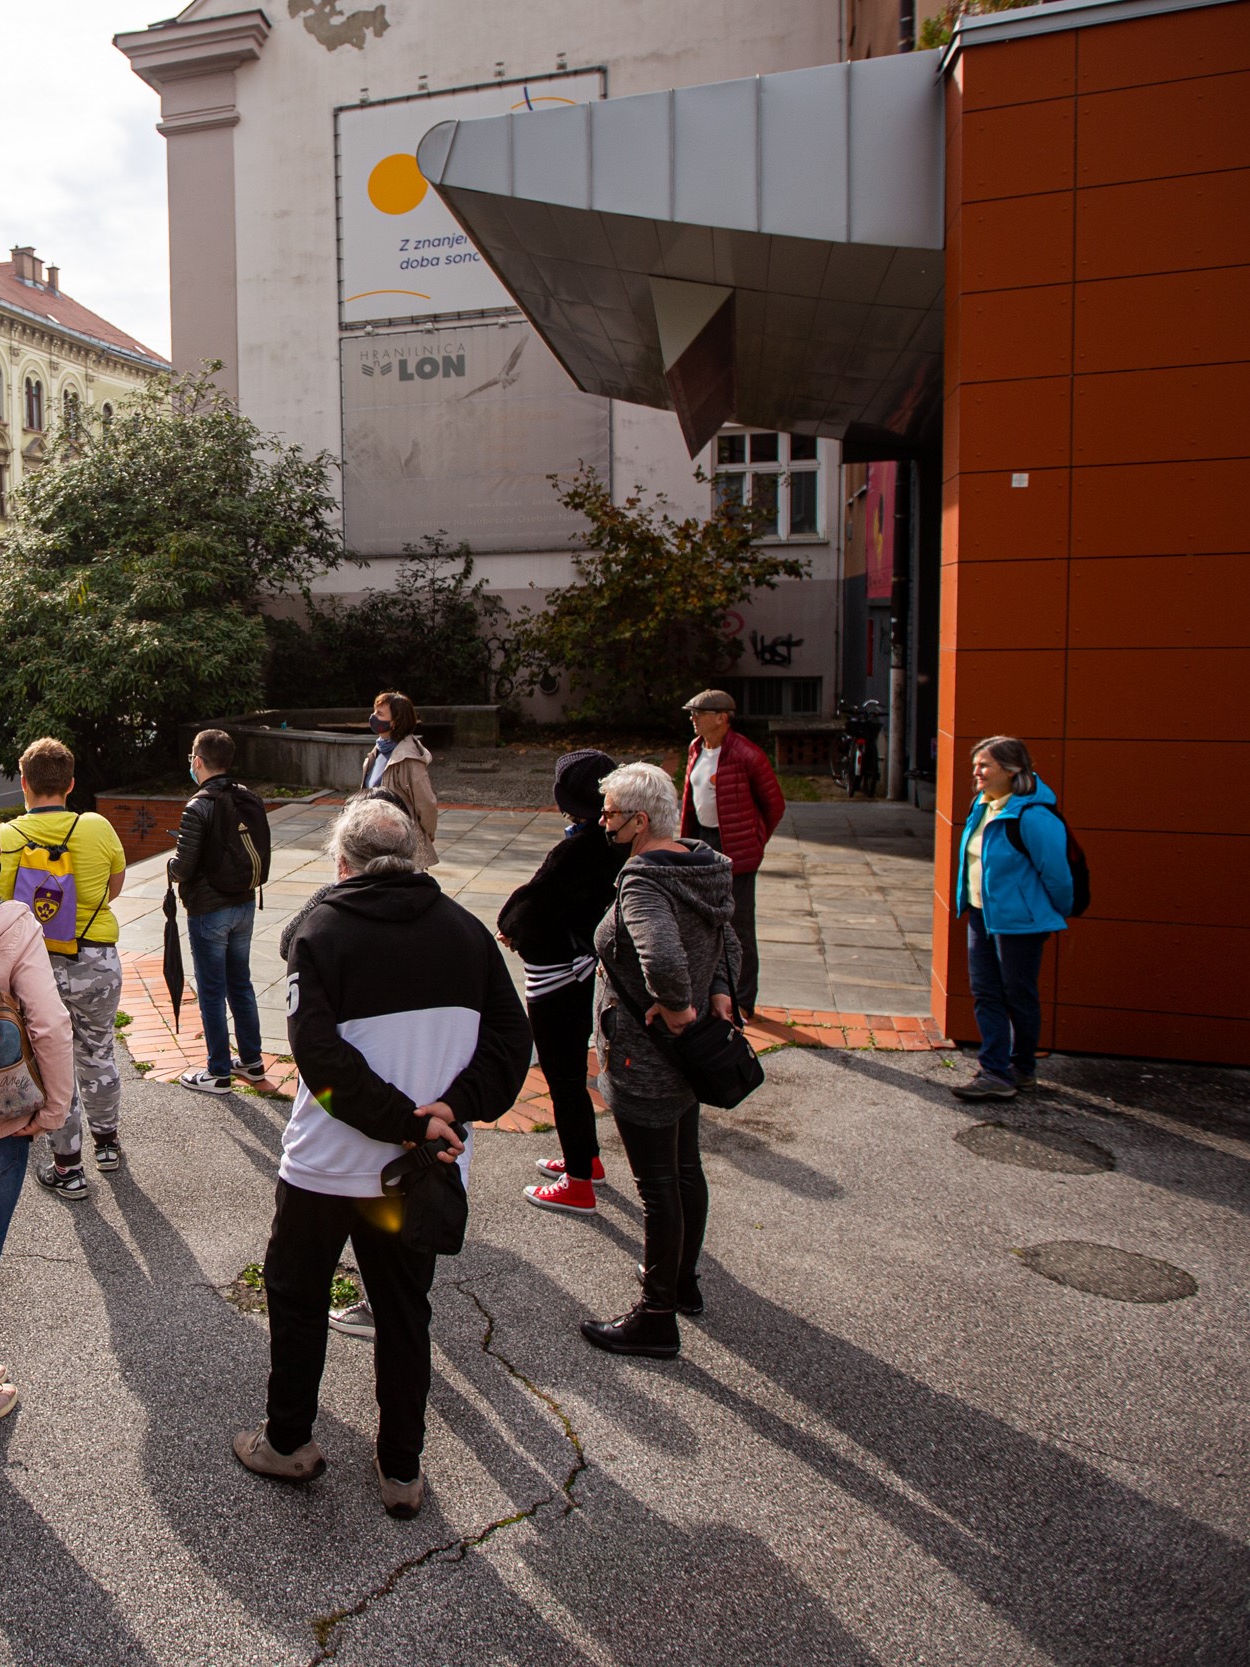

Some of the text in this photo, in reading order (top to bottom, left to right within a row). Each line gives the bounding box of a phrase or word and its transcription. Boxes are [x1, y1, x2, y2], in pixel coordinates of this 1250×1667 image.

[399, 239, 410, 252] Z
[400, 256, 440, 270] doba
[360, 343, 466, 360] HRANILNICA
[398, 354, 466, 382] LON
